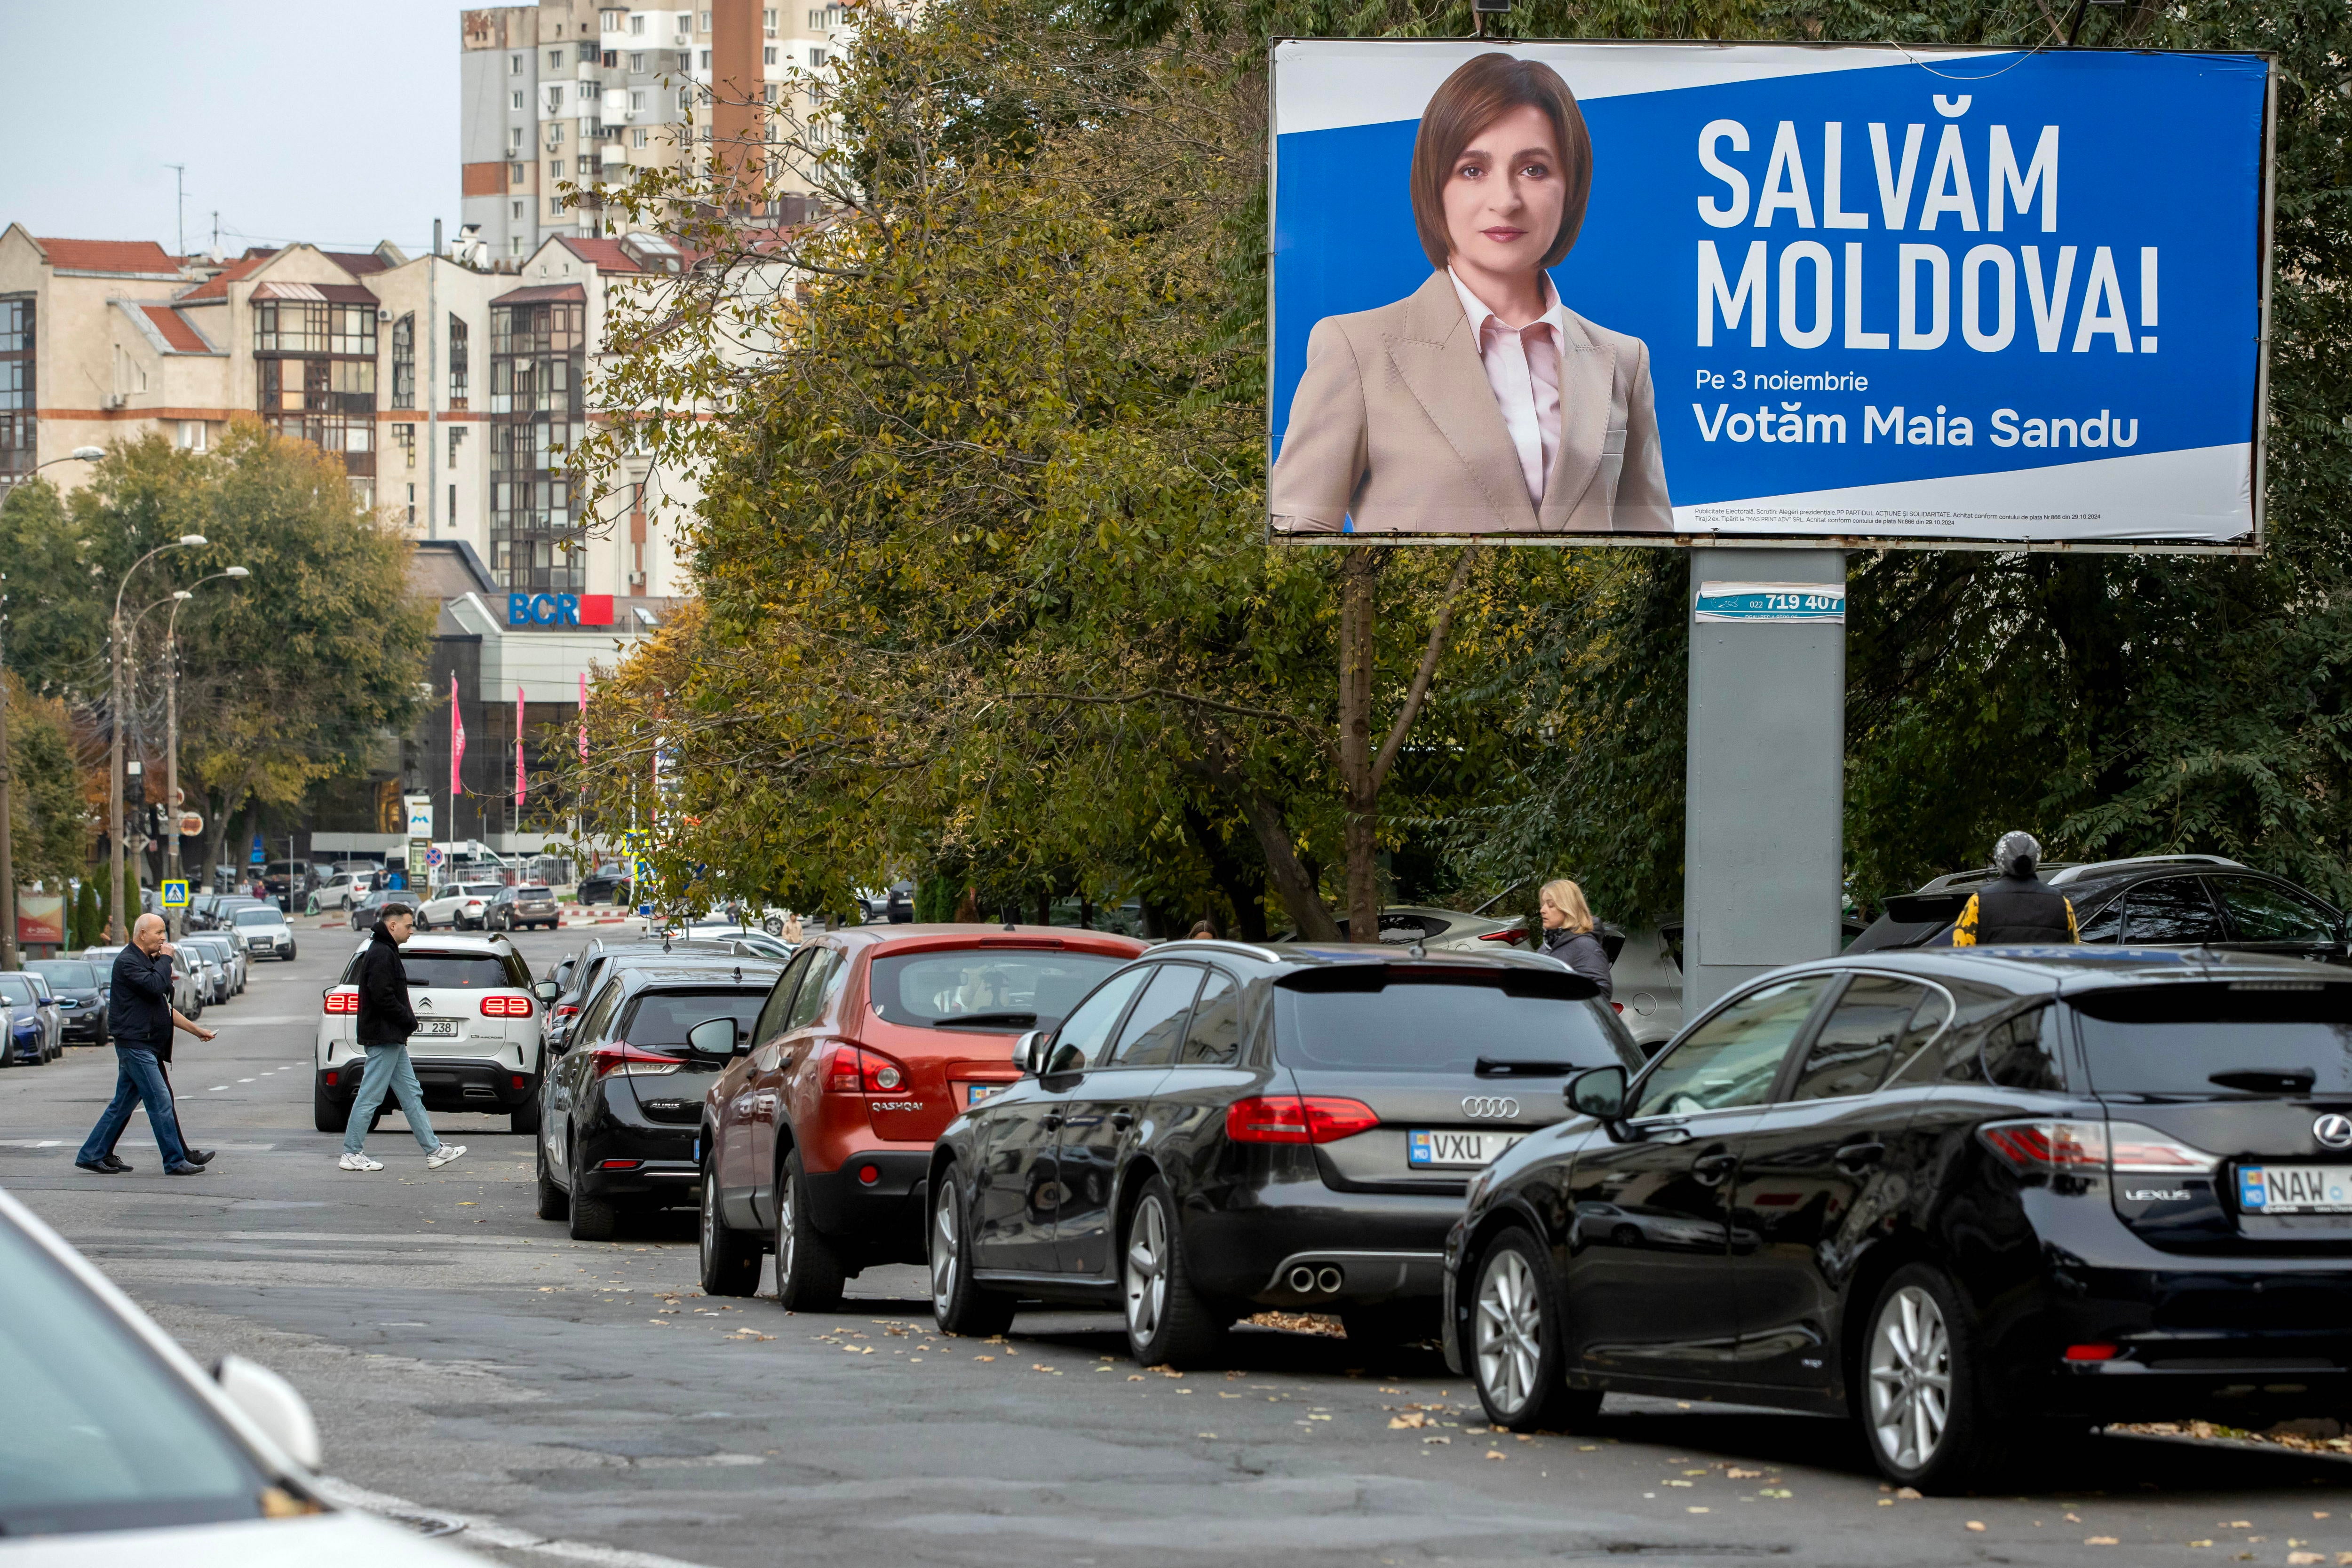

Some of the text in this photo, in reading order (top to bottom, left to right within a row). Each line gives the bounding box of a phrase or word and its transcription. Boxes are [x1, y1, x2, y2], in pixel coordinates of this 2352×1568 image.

[1697, 95, 2059, 232] SALVĂM
[1697, 240, 2158, 353] MOLDOVA!
[1696, 370, 1868, 391] Pe 3 noiembrie
[1692, 402, 2138, 448] Votăm Maia Sandu
[509, 593, 578, 625] BCR
[1766, 594, 1800, 609] 719
[432, 1023, 451, 1033] 238
[872, 1102, 923, 1111] QASHQAI
[1434, 1134, 1481, 1159] VXU
[2125, 1189, 2192, 1201] LEXUS
[2266, 1171, 2324, 1203] NAW
